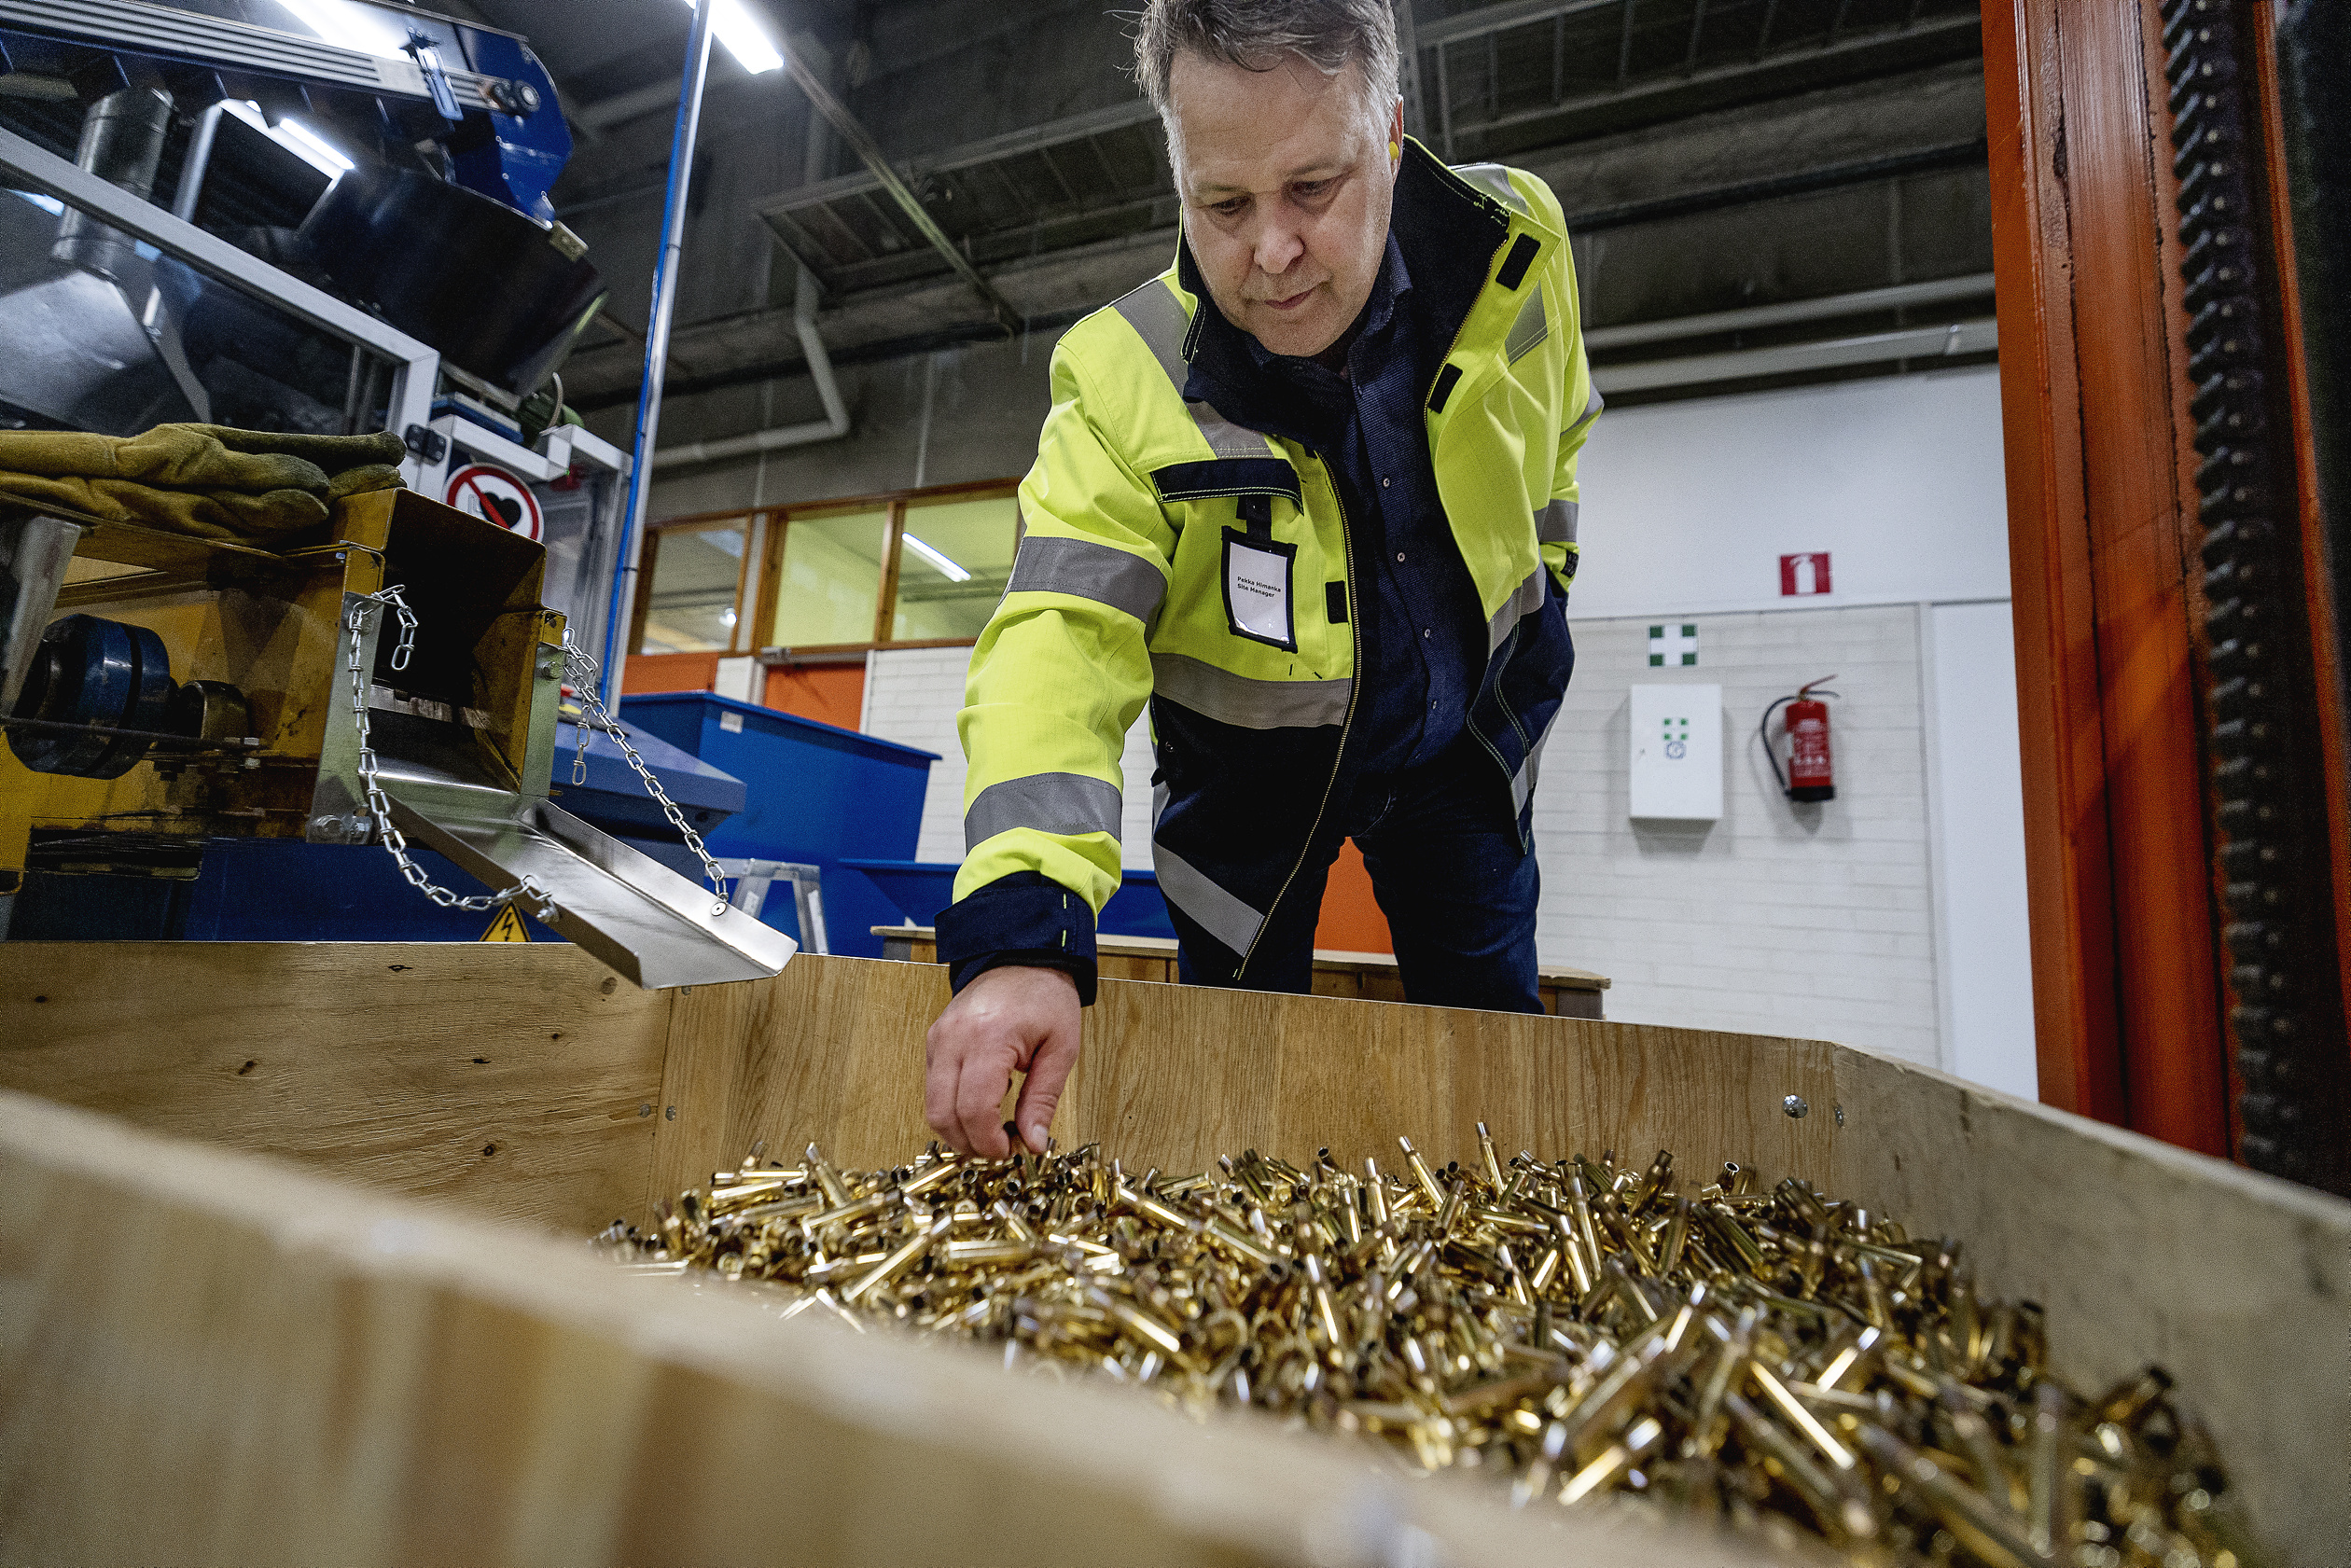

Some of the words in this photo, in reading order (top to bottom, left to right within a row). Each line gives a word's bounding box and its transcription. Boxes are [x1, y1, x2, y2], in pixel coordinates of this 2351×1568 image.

[1237, 576, 1255, 586] Pekka
[1237, 583, 1249, 591] Site
[1249, 587, 1275, 598] Manager
